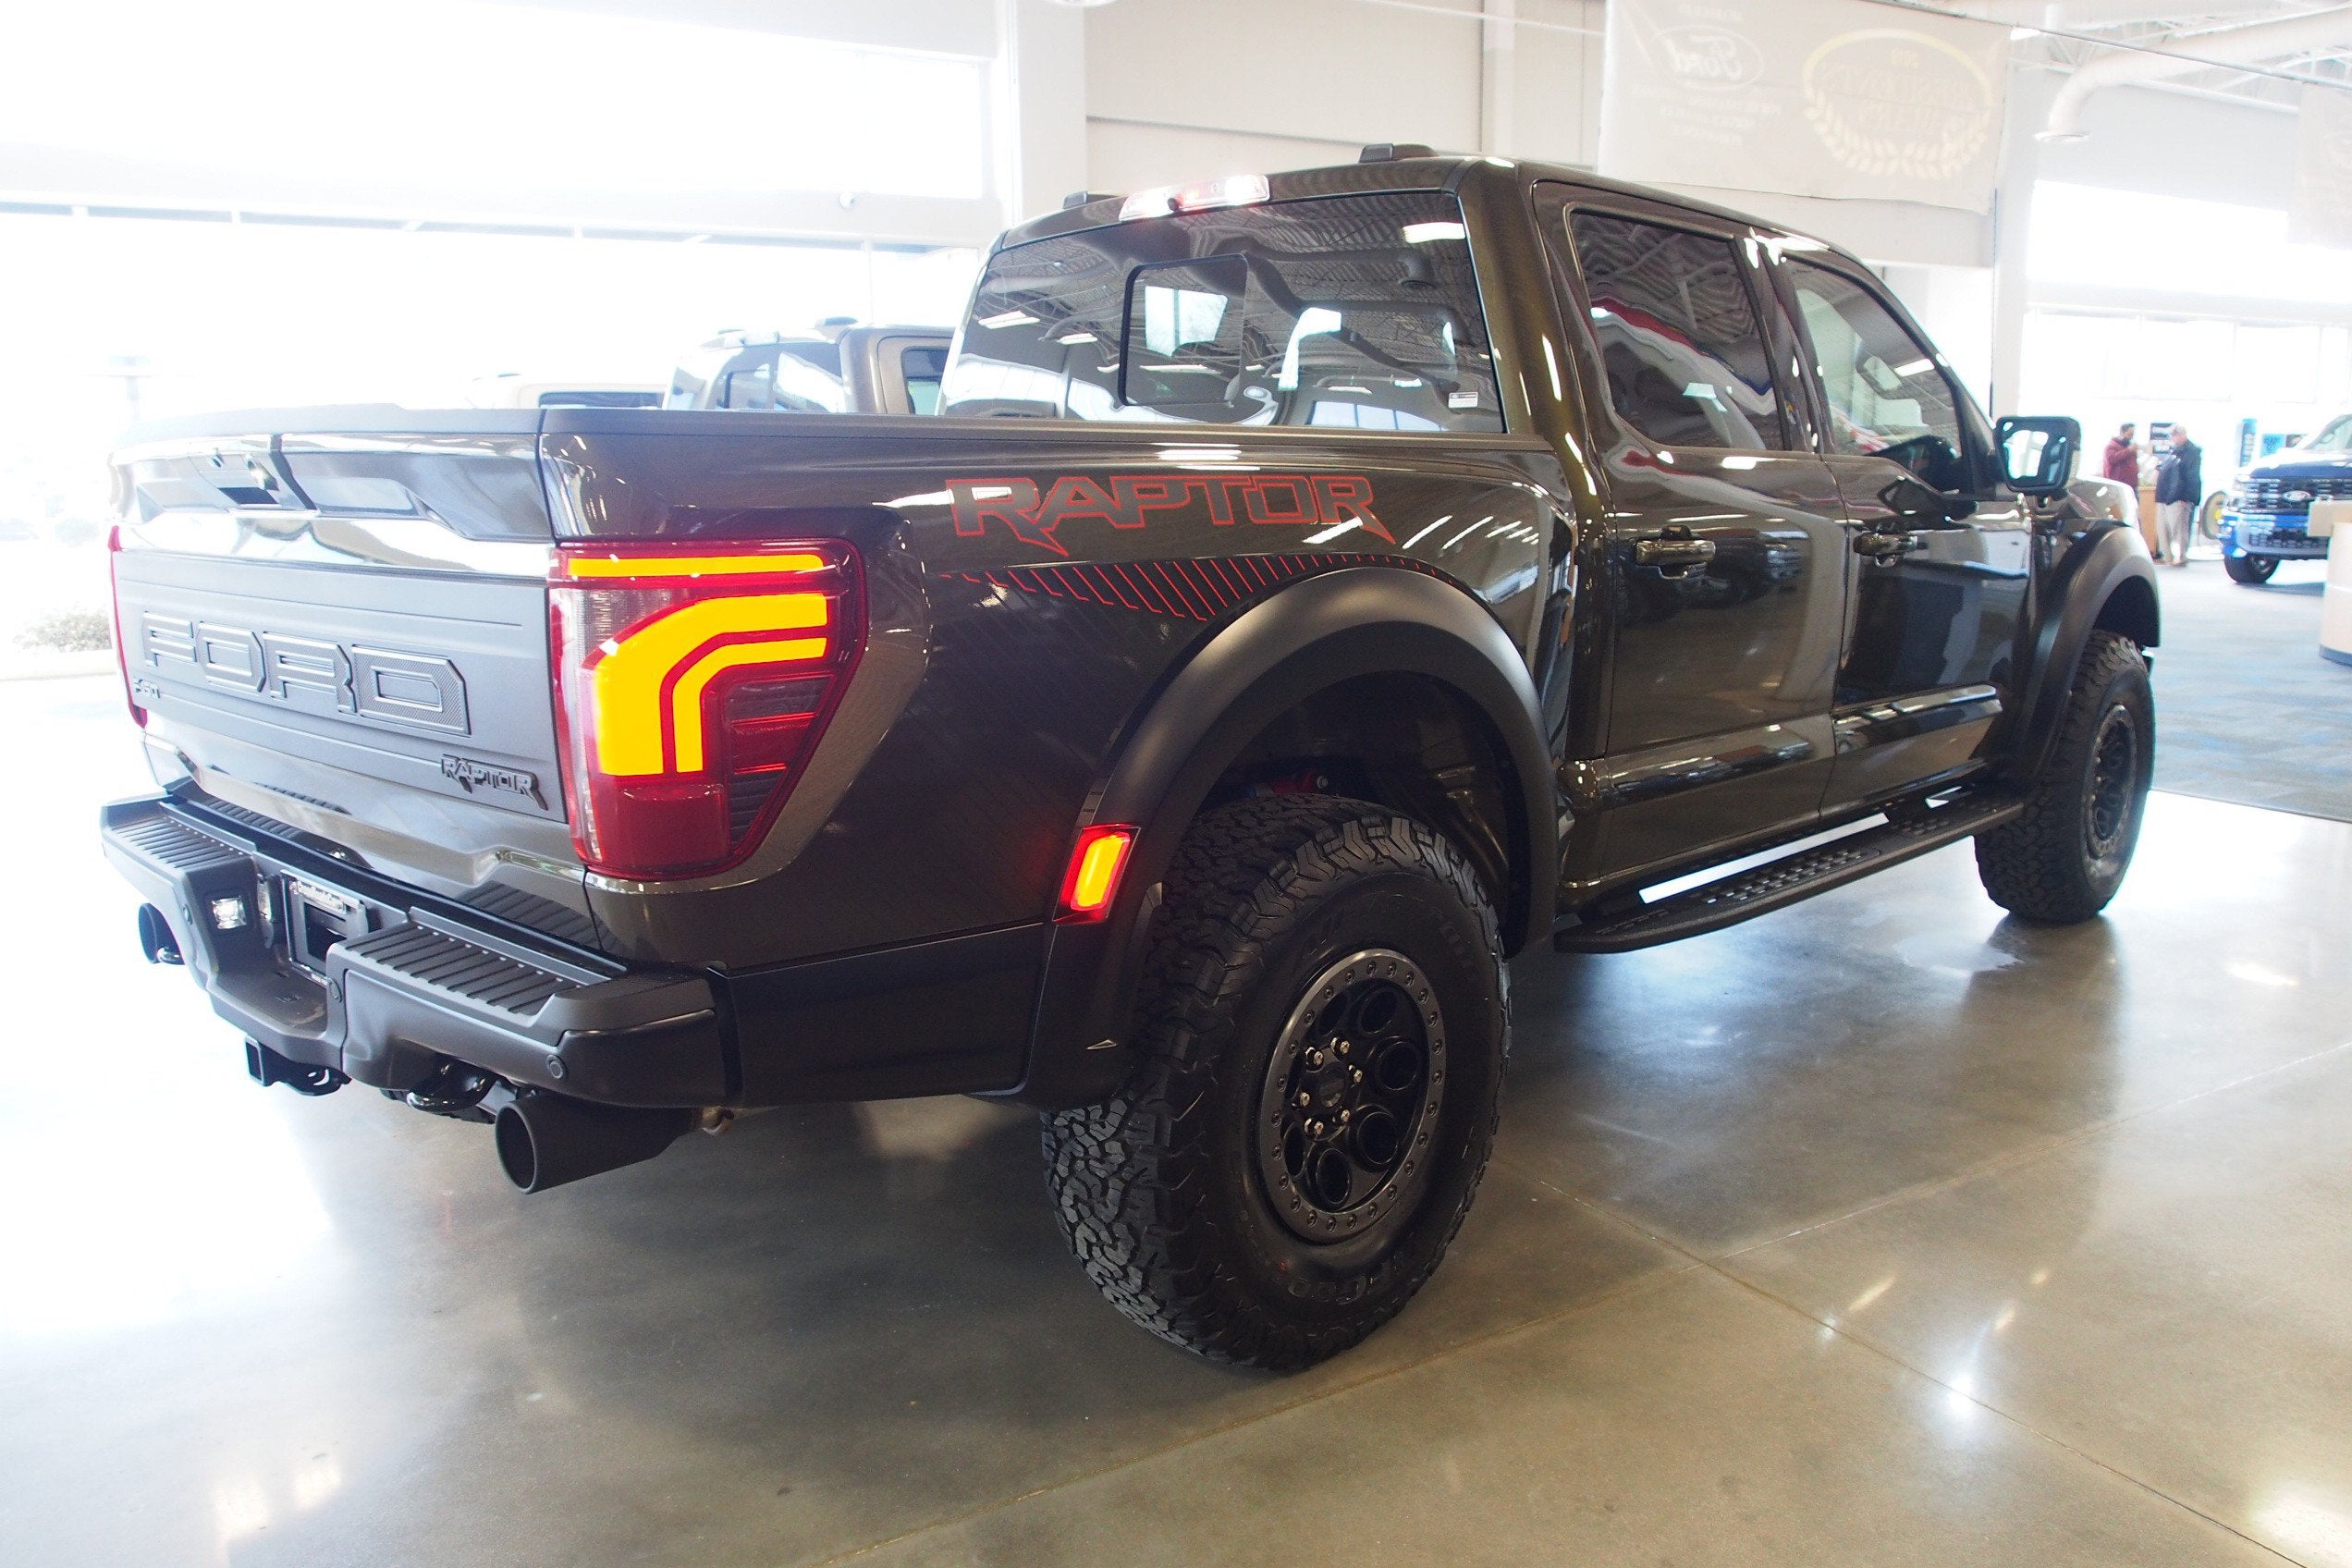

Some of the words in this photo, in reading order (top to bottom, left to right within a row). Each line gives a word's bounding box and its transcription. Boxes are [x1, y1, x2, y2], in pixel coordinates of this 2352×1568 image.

[945, 474, 1397, 557] RAPTOR
[141, 611, 471, 738] FORD
[442, 754, 548, 811] RAPTOR
